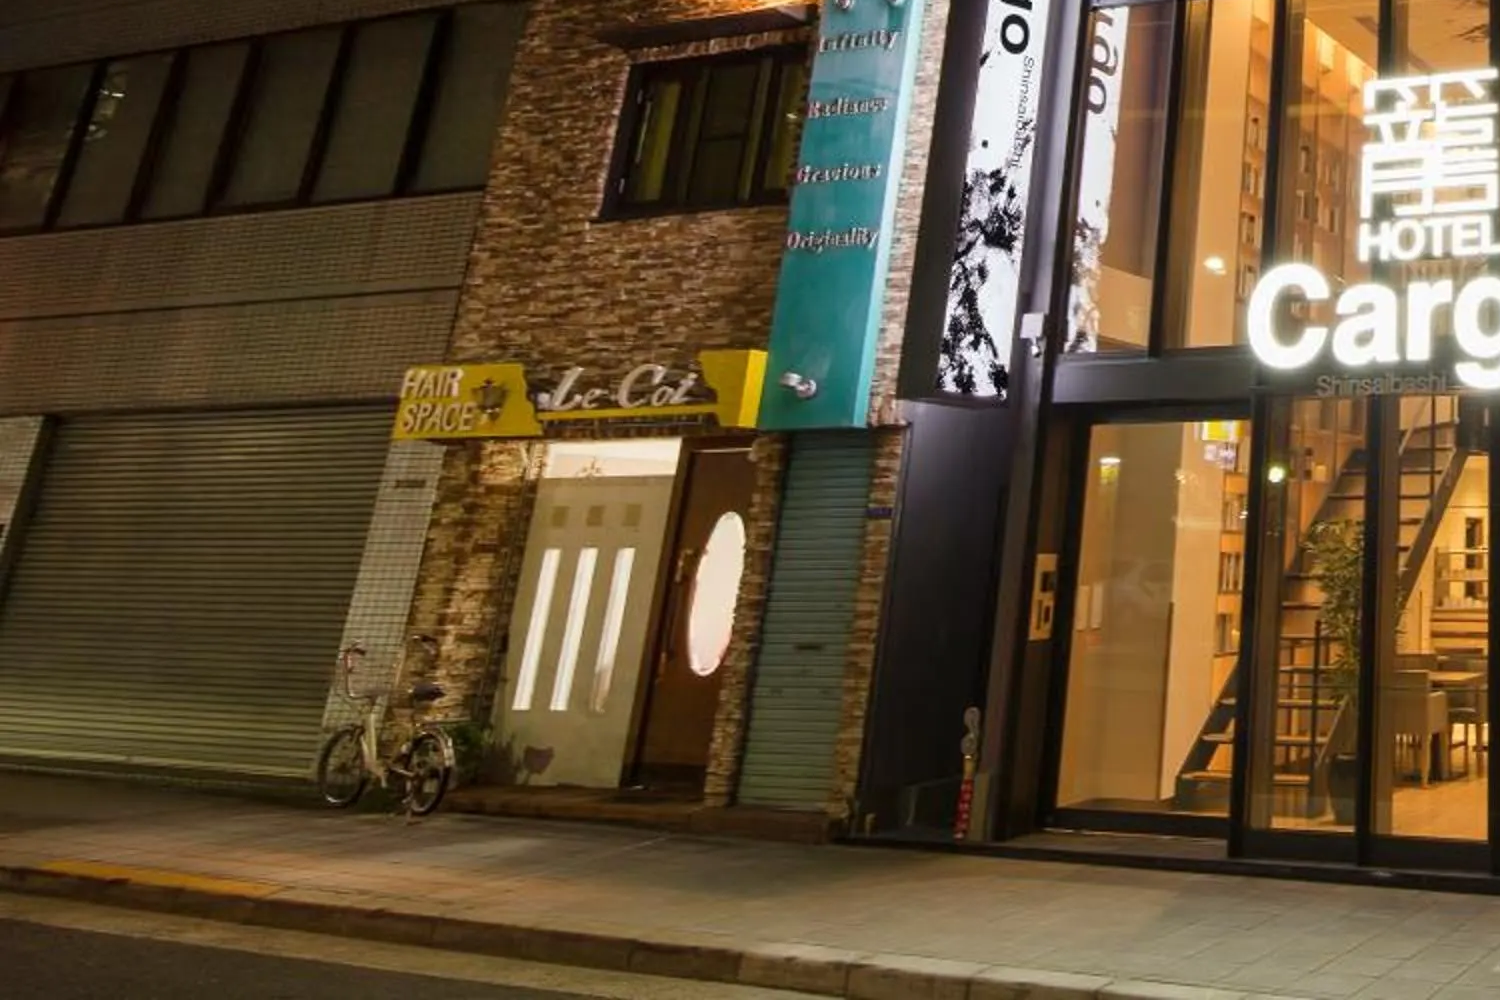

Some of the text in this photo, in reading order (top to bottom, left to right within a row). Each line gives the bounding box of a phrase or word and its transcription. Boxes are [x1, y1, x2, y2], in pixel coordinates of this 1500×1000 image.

[786, 226, 880, 254] Originality
[400, 367, 464, 398] HAIR
[537, 366, 607, 411] Le
[1316, 370, 1447, 397] Shinsaibashi
[402, 400, 478, 434] SPACE
